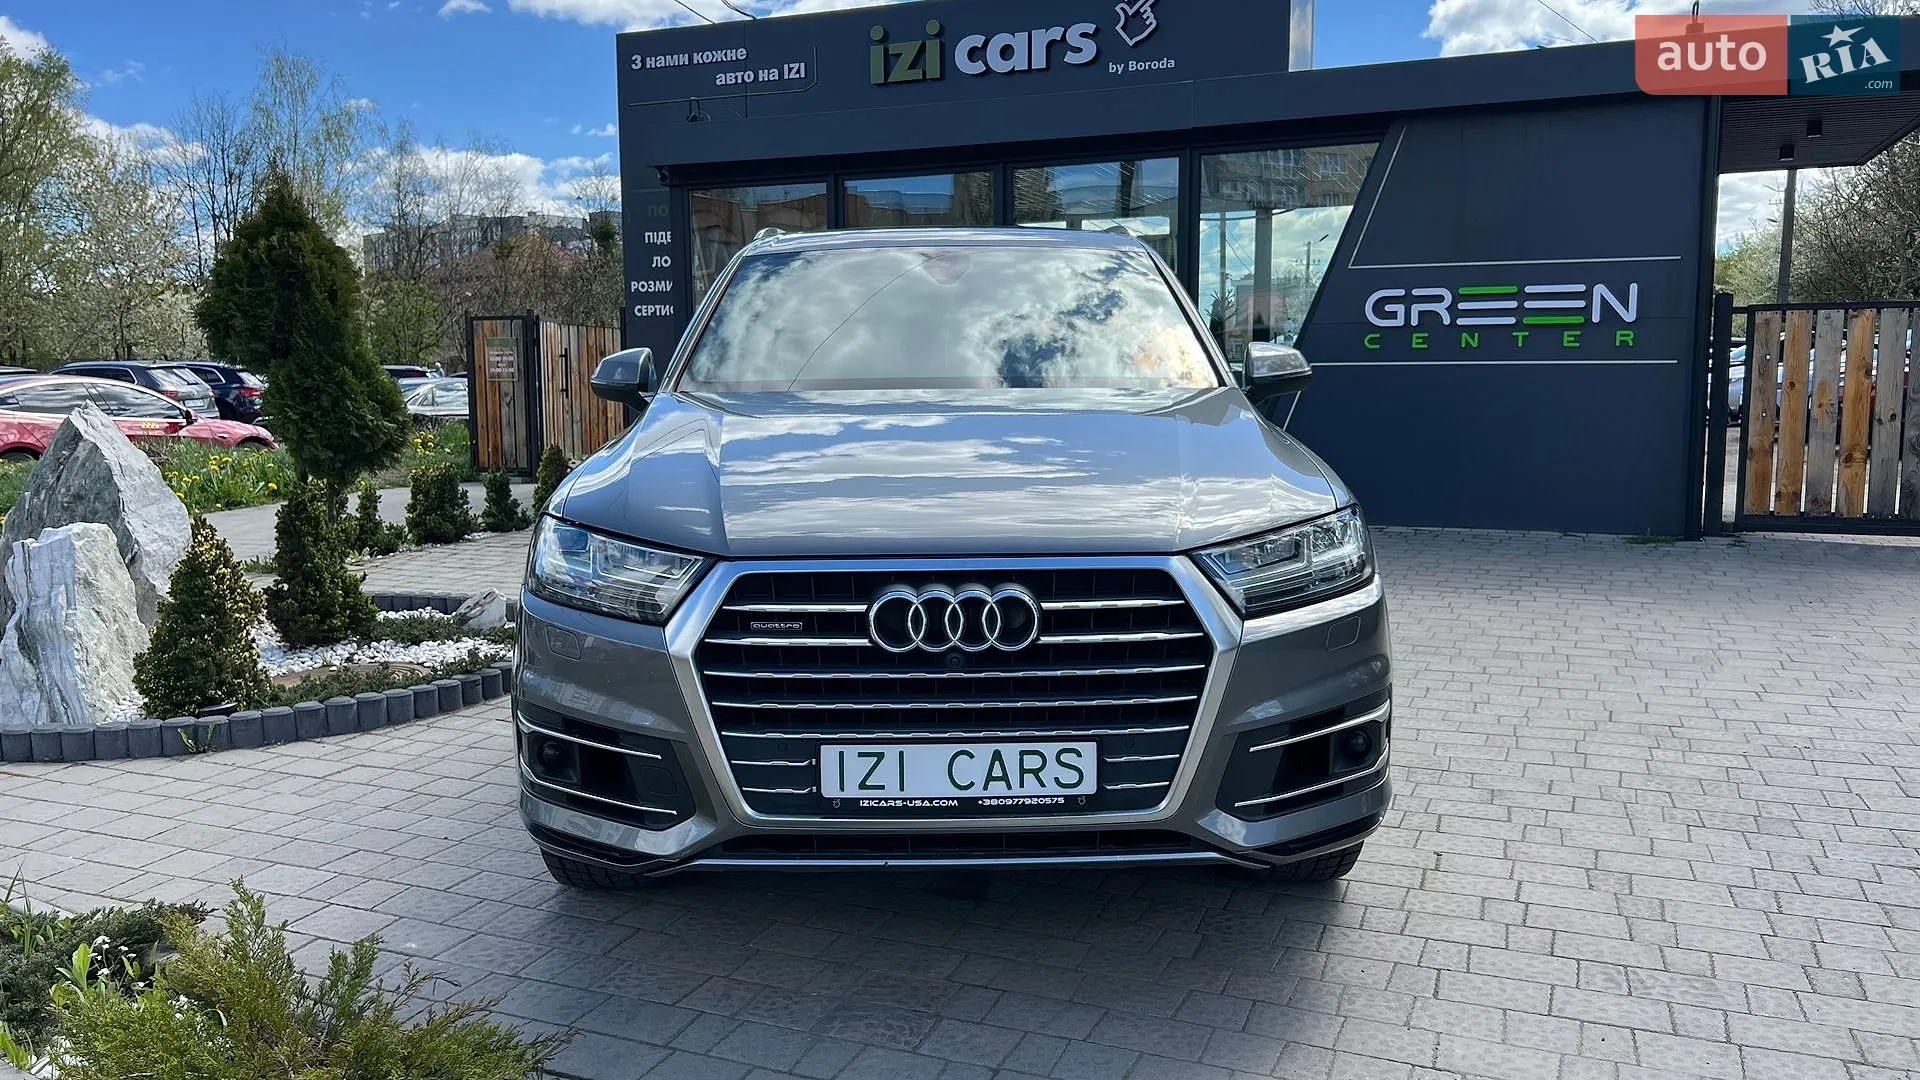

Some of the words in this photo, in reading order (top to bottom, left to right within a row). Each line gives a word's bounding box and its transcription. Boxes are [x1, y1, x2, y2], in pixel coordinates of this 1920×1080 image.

[646, 53, 689, 69] нами
[693, 47, 748, 64] кожне
[870, 19, 940, 85] izi
[954, 22, 1097, 75] cars
[715, 70, 754, 86] авто
[758, 68, 779, 82] на
[783, 62, 805, 80] IZI
[1108, 61, 1124, 74] by
[1128, 57, 1175, 71] Boroda
[1364, 282, 1638, 327] GREEN
[1364, 330, 1635, 349] CENTER
[838, 750, 904, 792] IZI
[947, 748, 1085, 791] CARS
[859, 799, 958, 807] IZICARS-USA.COM
